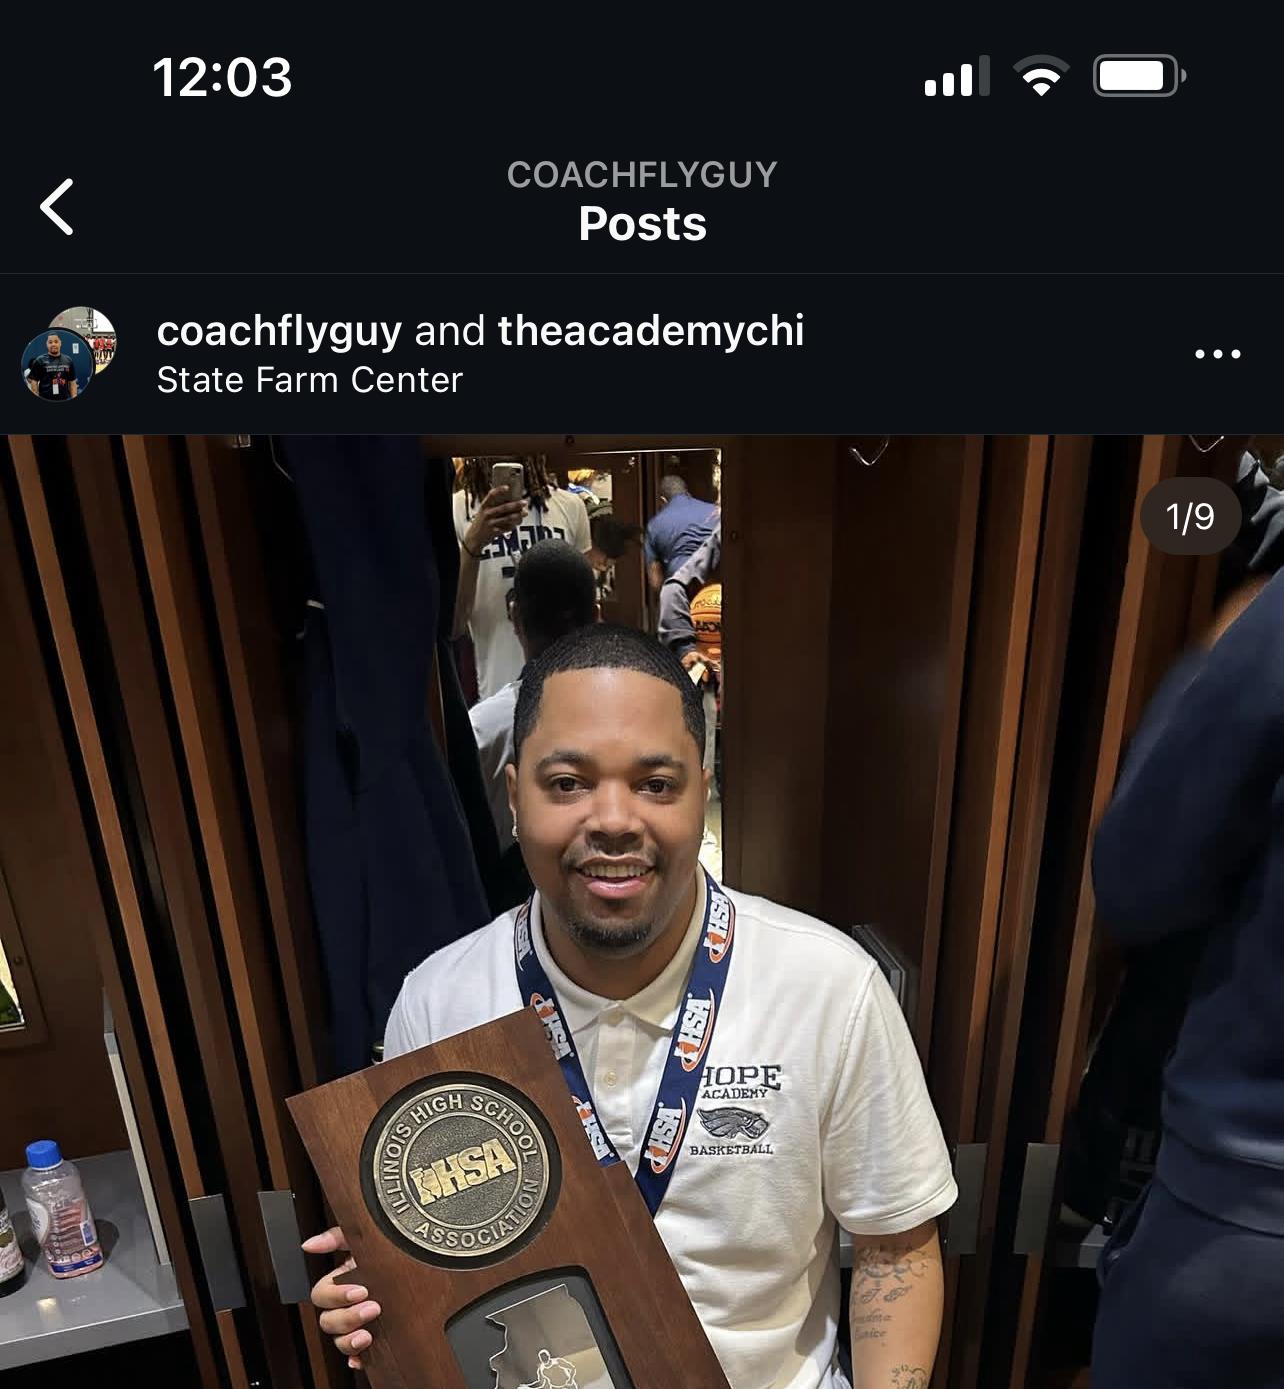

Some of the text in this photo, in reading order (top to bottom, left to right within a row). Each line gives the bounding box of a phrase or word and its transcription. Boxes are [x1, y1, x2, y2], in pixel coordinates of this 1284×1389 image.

[703, 889, 731, 954] IHSA
[674, 997, 712, 1063] IHSA
[701, 1088, 768, 1099] ACADEMY
[383, 1093, 538, 1215] ILLINOIS HIGH SCHOOL
[645, 1106, 685, 1166] IHSA
[689, 1144, 773, 1156] BASKETBALL
[408, 1138, 517, 1207] IHSA
[414, 1178, 539, 1248] ASSOCIATION
